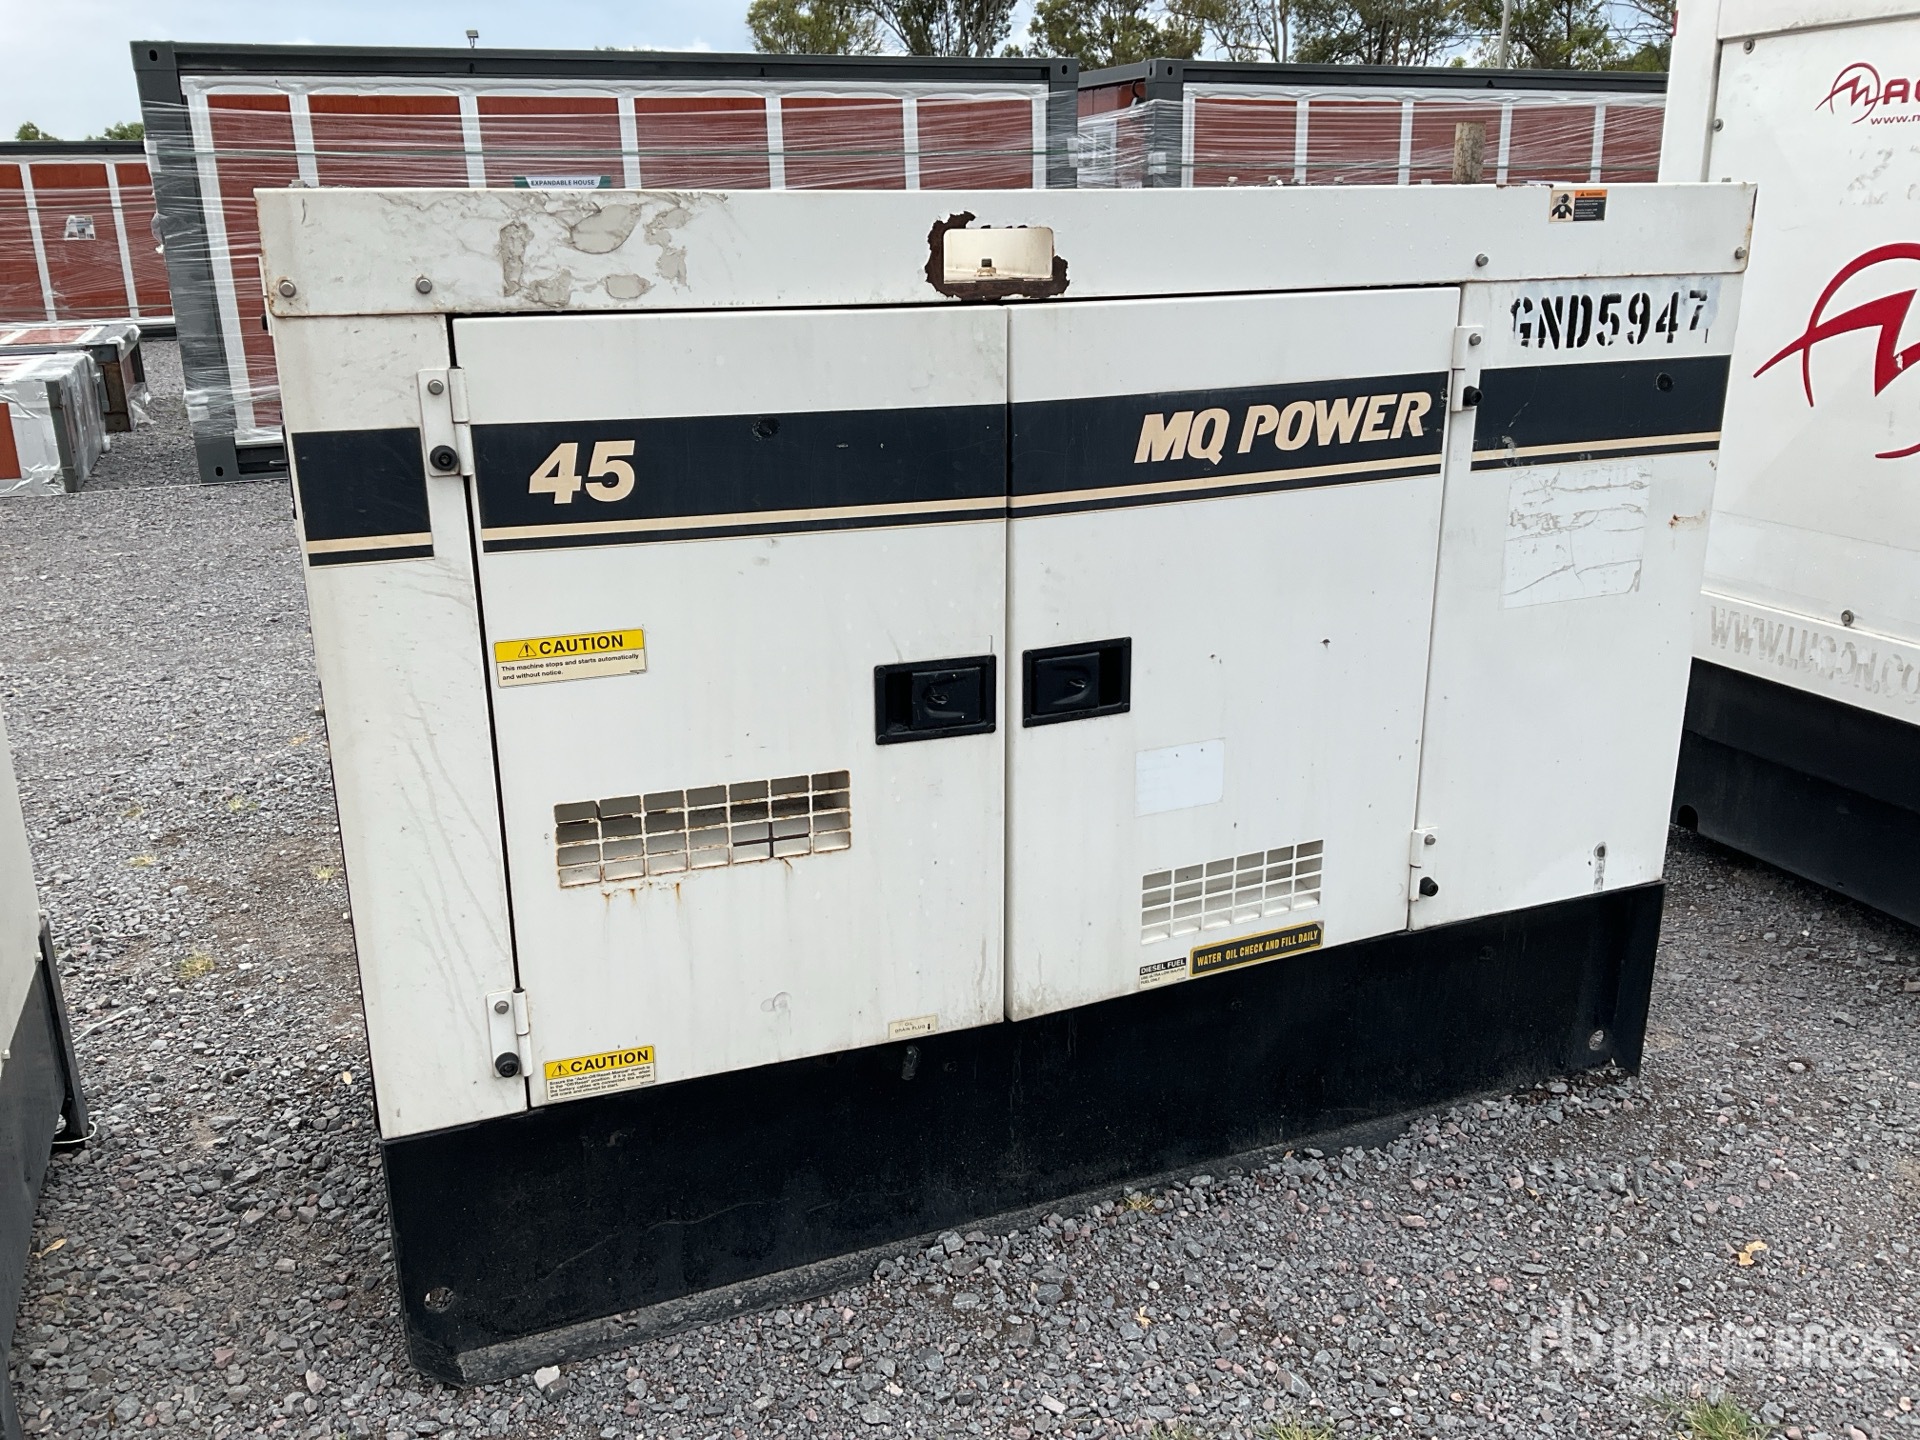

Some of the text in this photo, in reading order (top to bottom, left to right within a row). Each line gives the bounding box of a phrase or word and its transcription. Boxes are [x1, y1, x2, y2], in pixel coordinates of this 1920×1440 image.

[1510, 290, 1708, 349] GND5947
[1133, 391, 1432, 465] MQ POWER
[528, 440, 635, 504] 45
[539, 634, 623, 655] CAUTION
[516, 663, 544, 671] machine
[597, 653, 639, 663] automatically
[1197, 930, 1318, 967] WATER OIL CHECK AND FILL DAILY
[1140, 959, 1185, 974] DIESEL FUEL
[571, 1050, 648, 1072] CAUTION
